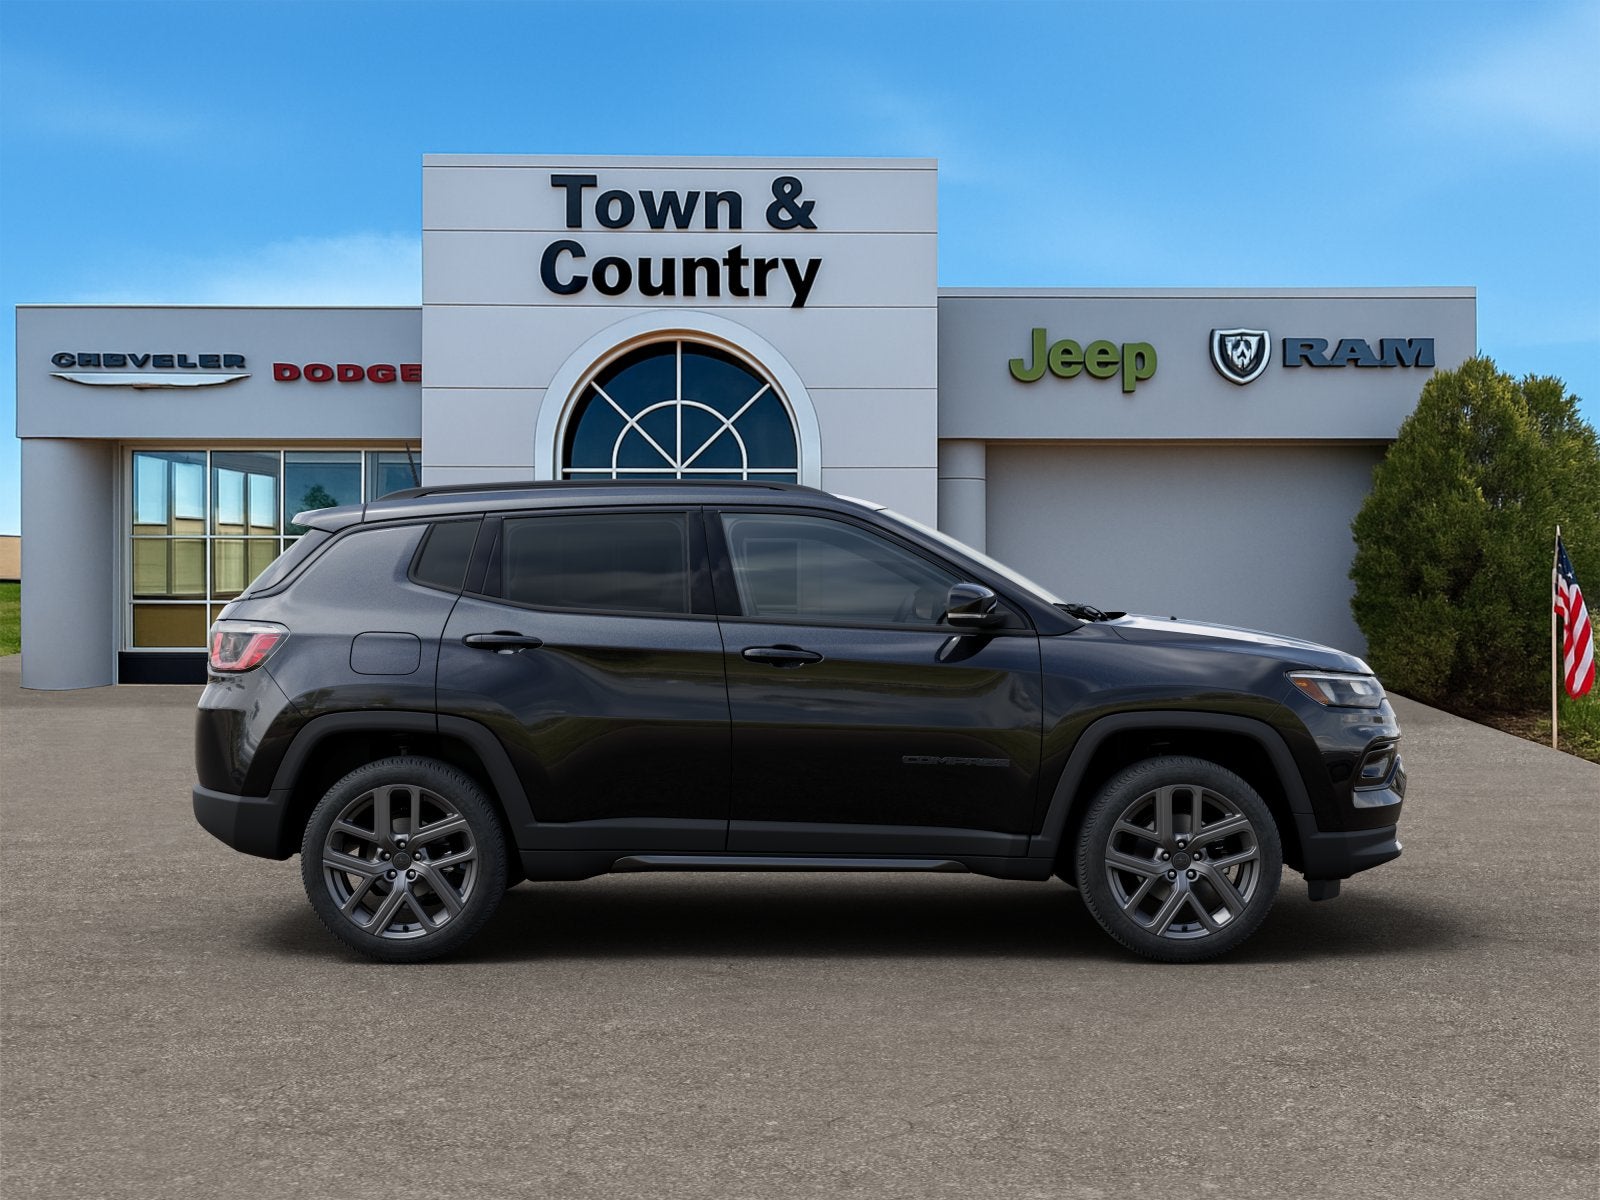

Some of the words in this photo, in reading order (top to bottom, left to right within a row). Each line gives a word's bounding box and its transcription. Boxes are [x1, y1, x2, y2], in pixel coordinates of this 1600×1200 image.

[550, 174, 743, 230] Town
[765, 175, 818, 230] &
[540, 239, 822, 308] Country
[272, 362, 422, 383] DODGE
[1009, 327, 1157, 393] Jeep
[1283, 337, 1436, 368] RAM
